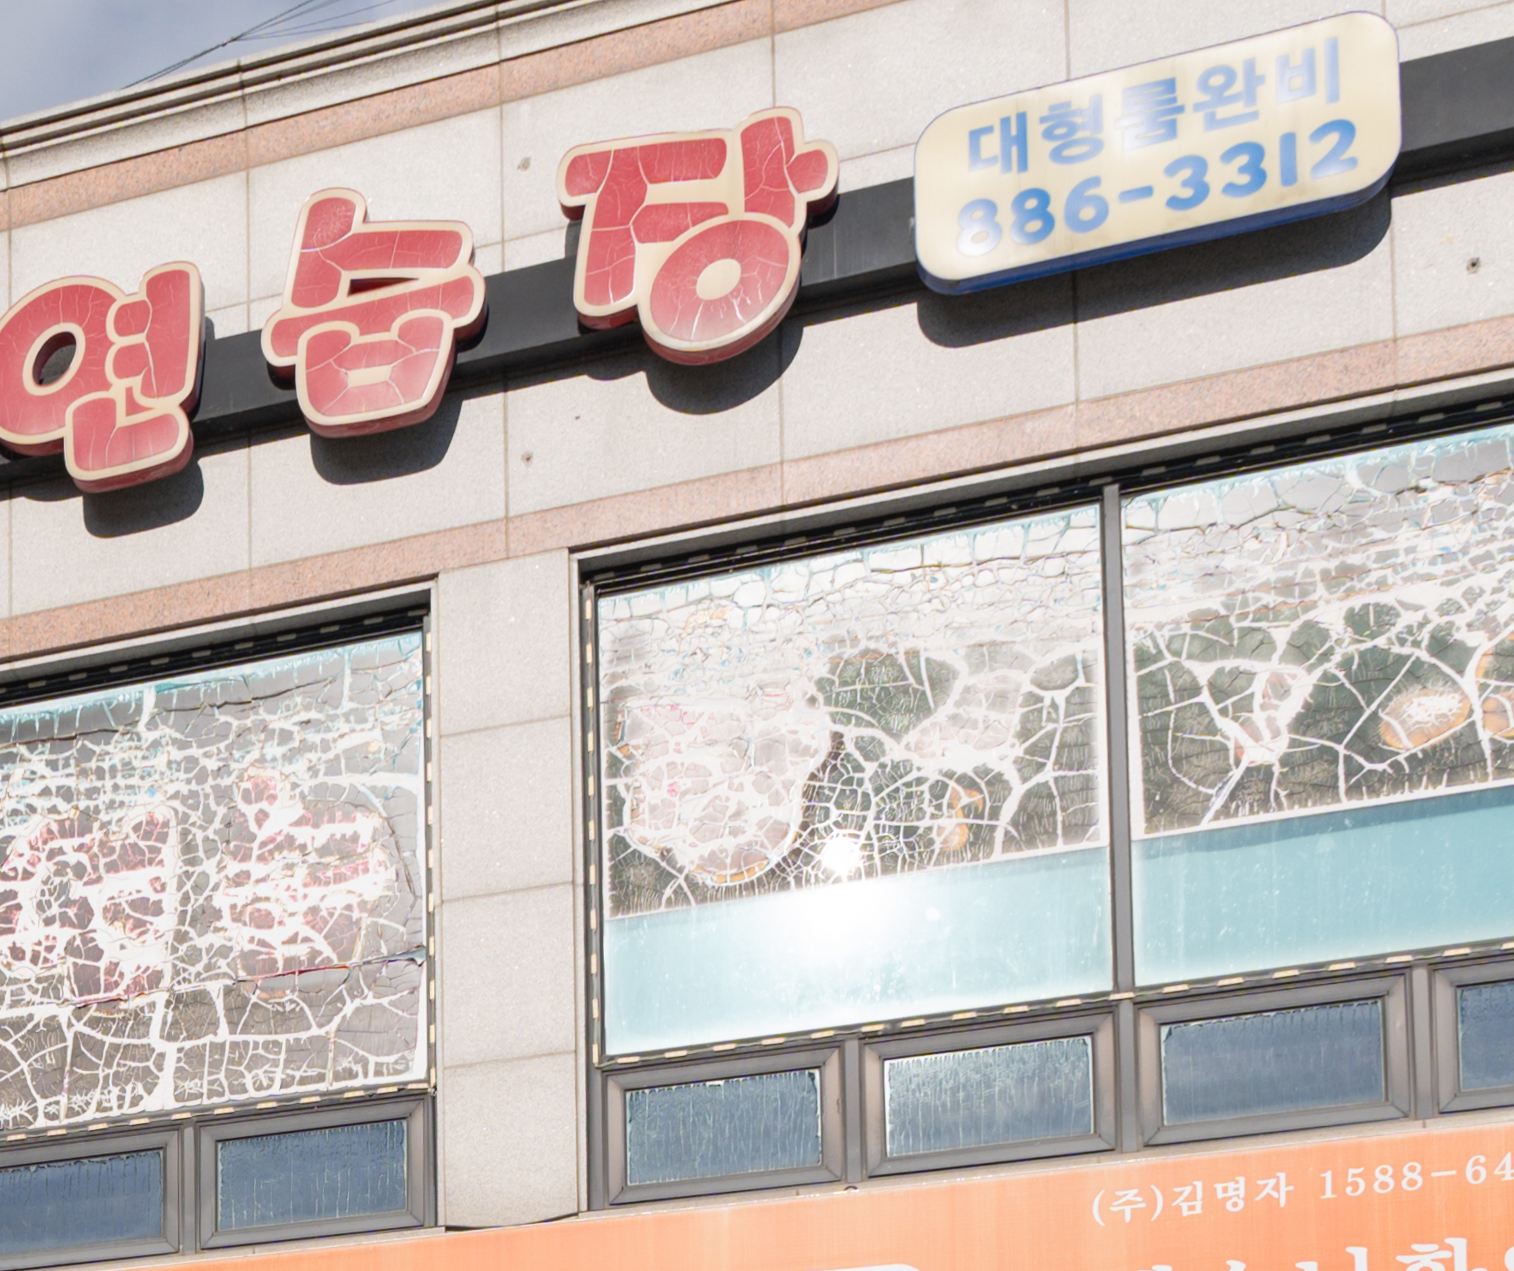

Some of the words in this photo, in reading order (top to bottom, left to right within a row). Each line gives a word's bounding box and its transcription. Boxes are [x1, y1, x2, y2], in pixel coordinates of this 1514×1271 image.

[968, 37, 1340, 174] 대형룸완비
[956, 118, 1359, 258] 886-3312
[1092, 1172, 1295, 1227] (주)김명자
